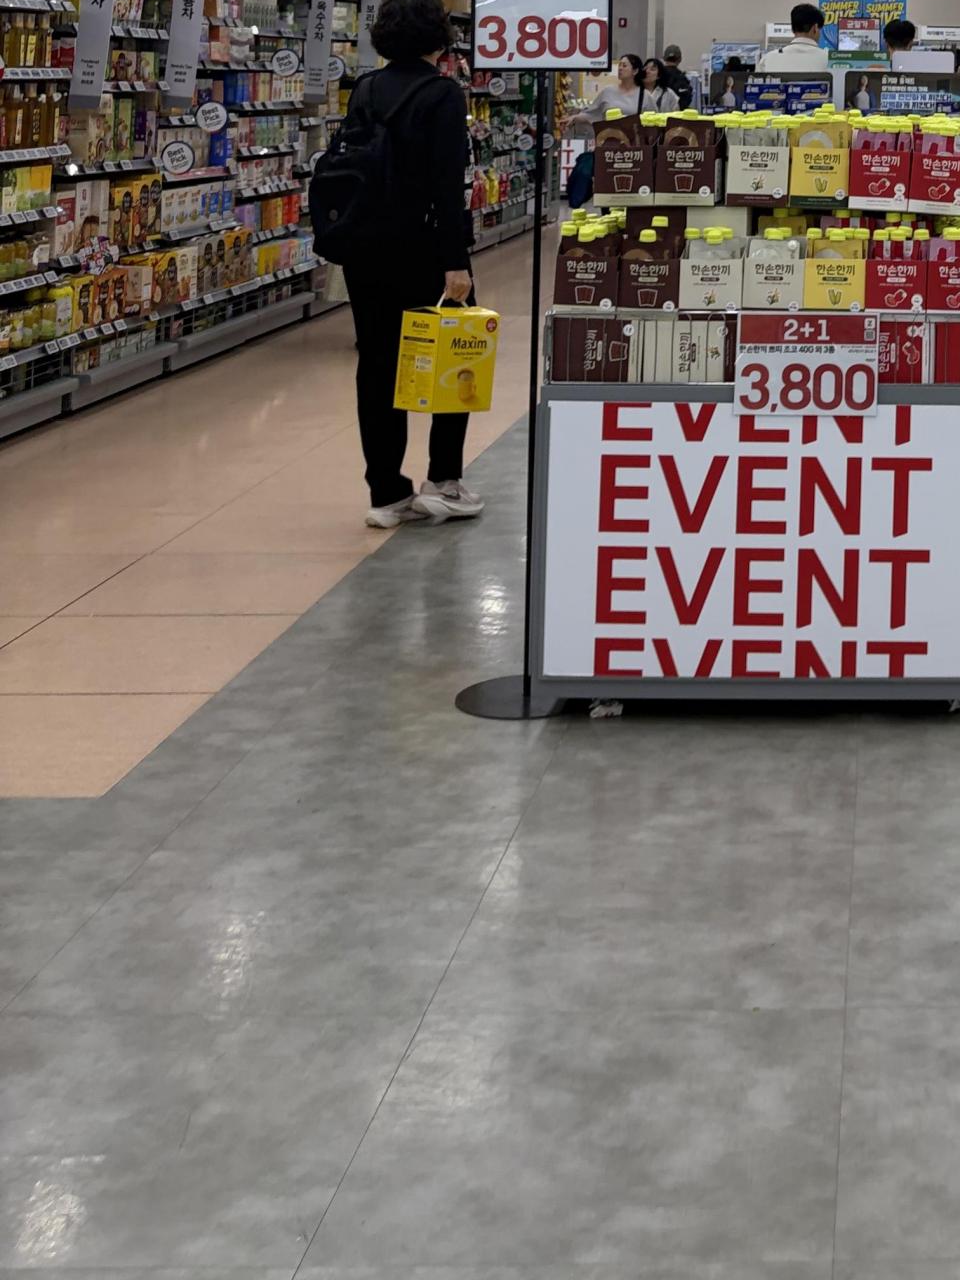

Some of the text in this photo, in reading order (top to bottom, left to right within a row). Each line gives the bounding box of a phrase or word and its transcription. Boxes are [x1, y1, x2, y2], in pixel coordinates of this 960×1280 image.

[821, 1, 860, 11] SUMMER
[866, 3, 904, 13] SUMMER
[477, 15, 608, 62] 3,800
[276, 53, 291, 63] Best
[278, 59, 293, 68] Pick
[201, 106, 219, 116] Best
[203, 113, 221, 123] Pick
[166, 149, 185, 158] Best
[170, 155, 187, 165] Pick
[604, 150, 643, 163] 한손한끼
[666, 150, 705, 163] 한손한끼
[739, 150, 779, 163] 한손한끼
[803, 153, 841, 165] 한손한끼
[861, 154, 900, 167] 한손한끼
[922, 158, 960, 172] 한손한끼
[566, 260, 607, 273] 한손한끼
[629, 263, 669, 276] 한손한끼
[690, 263, 731, 276] 한손한끼
[754, 263, 794, 276] 한손한끼
[816, 263, 856, 276] 한손한끼
[877, 264, 917, 278] 한손한끼
[783, 318, 831, 341] 2+1
[450, 336, 488, 350] Maxim
[799, 345, 814, 353] 40G
[679, 332, 691, 373] 한손한끼
[739, 362, 876, 412] 3,800
[597, 453, 933, 538] EVENT
[594, 545, 931, 631] EVENT
